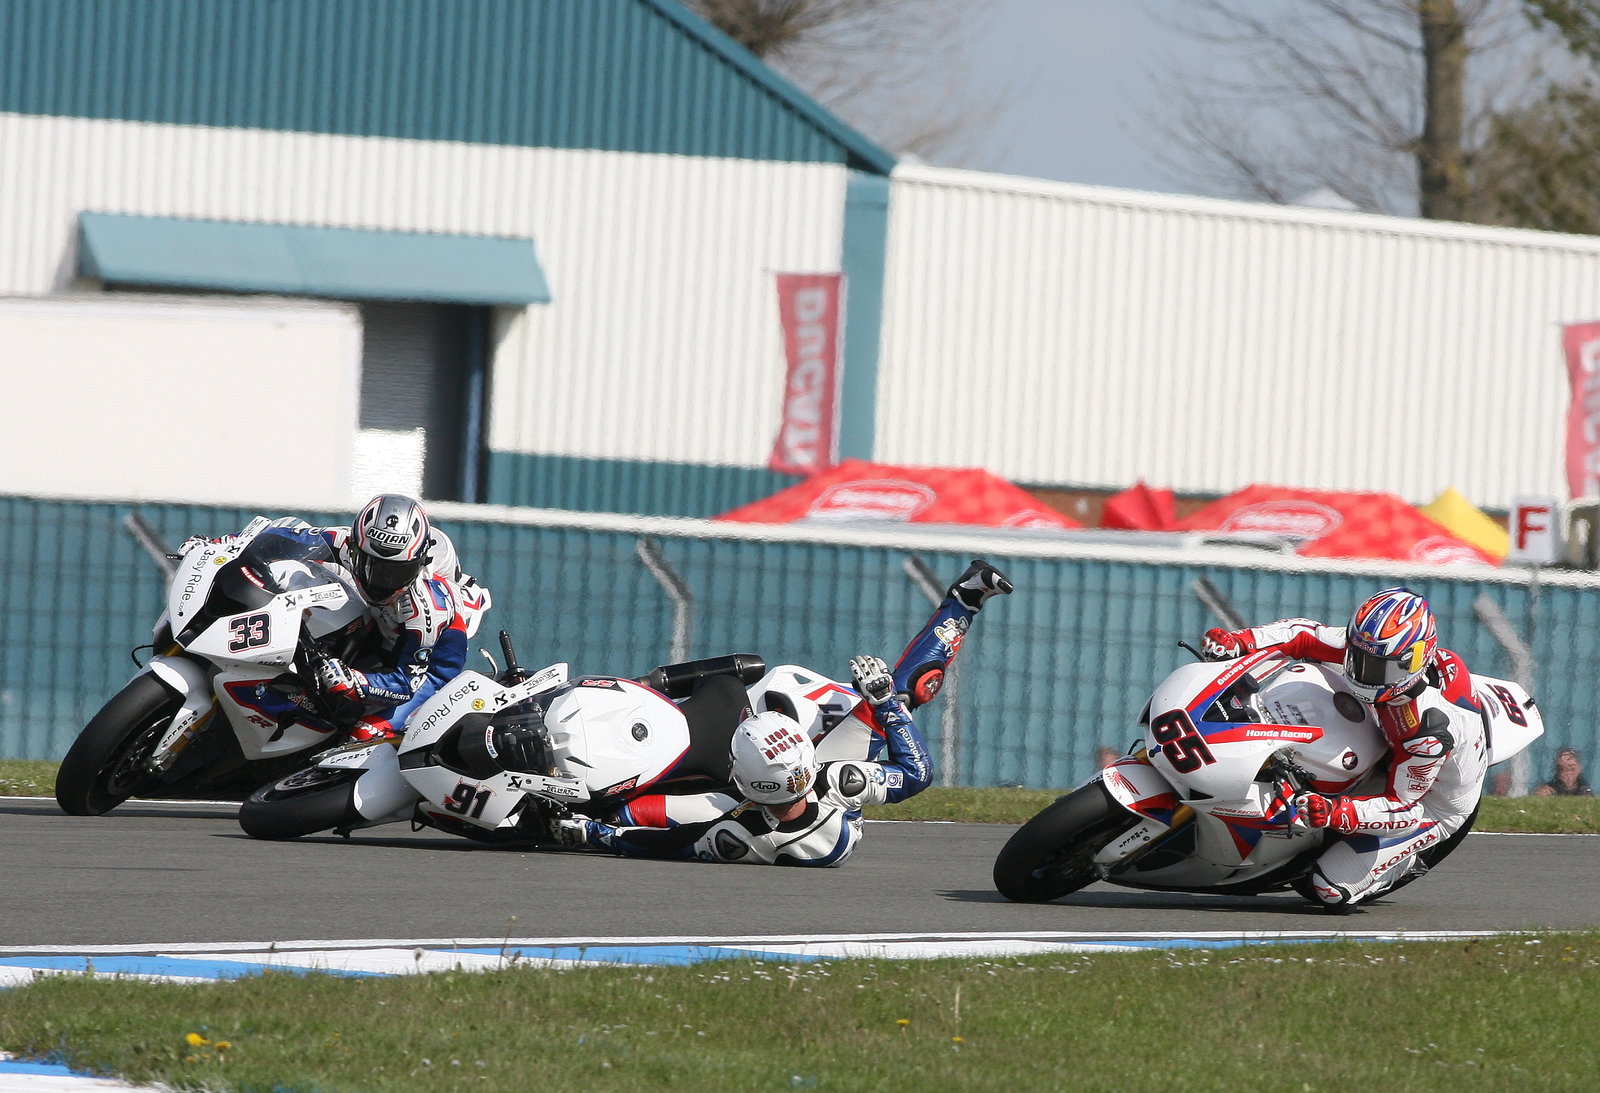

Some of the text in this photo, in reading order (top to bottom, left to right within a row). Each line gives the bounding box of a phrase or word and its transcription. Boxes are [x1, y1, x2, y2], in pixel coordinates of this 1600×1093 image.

[367, 527, 411, 546] NOLAN
[1516, 505, 1549, 550] F
[228, 611, 271, 653] 33
[1216, 649, 1268, 686] Honda Racing
[449, 680, 480, 707] 3asy
[1215, 699, 1230, 721] HONDA
[162, 710, 199, 746] PIRELLI
[1151, 708, 1217, 774] 65
[1246, 729, 1313, 739] Honda Racing
[445, 780, 493, 820] 91
[1357, 818, 1419, 830] HONDA
[1371, 832, 1438, 876] HONDA
